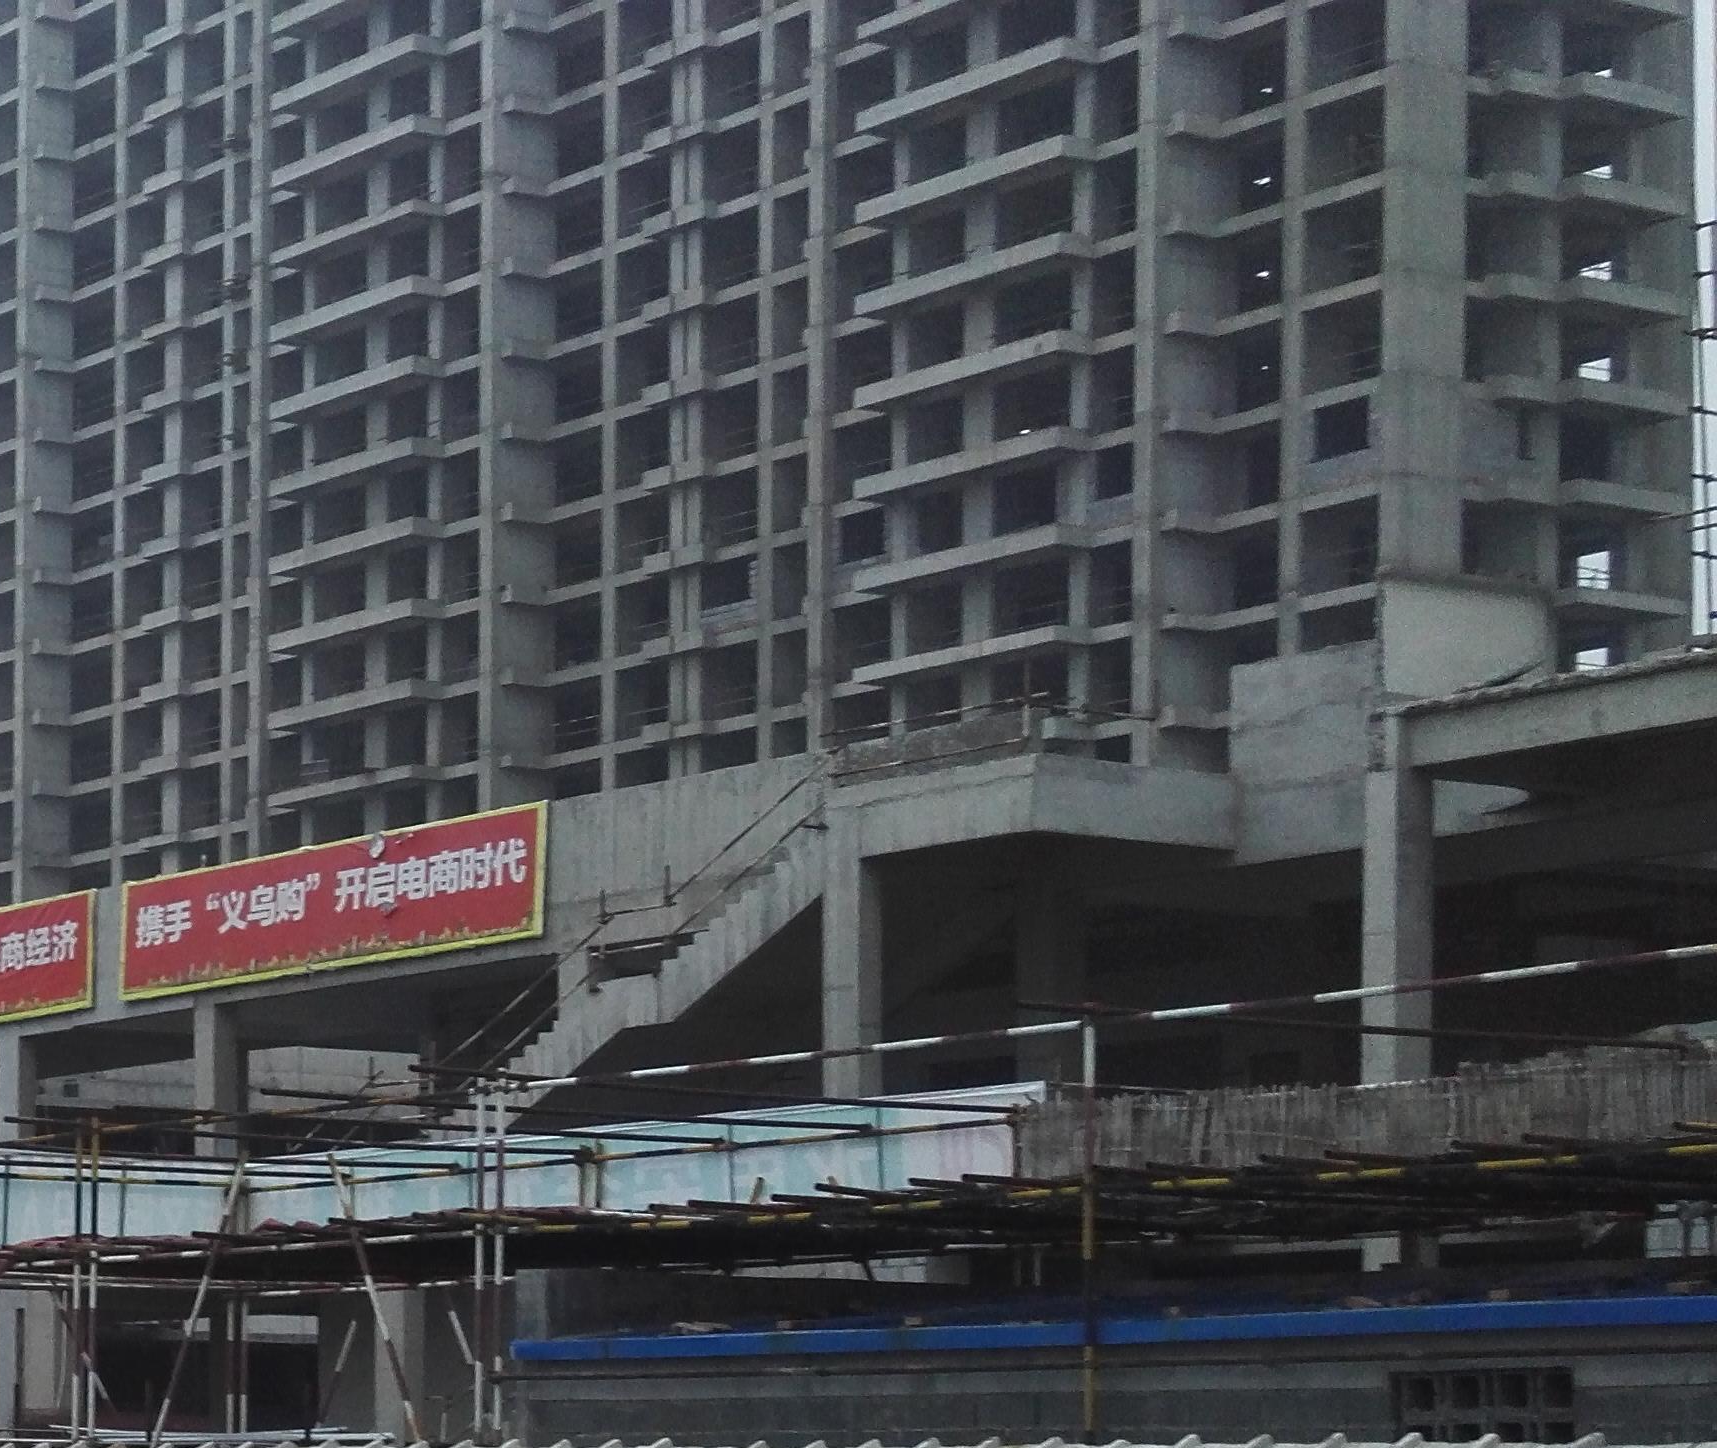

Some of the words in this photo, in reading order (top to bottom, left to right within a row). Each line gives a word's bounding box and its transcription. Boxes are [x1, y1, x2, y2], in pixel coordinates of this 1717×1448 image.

[136, 901, 192, 948] 携手
[334, 838, 526, 913] 开启电商时代
